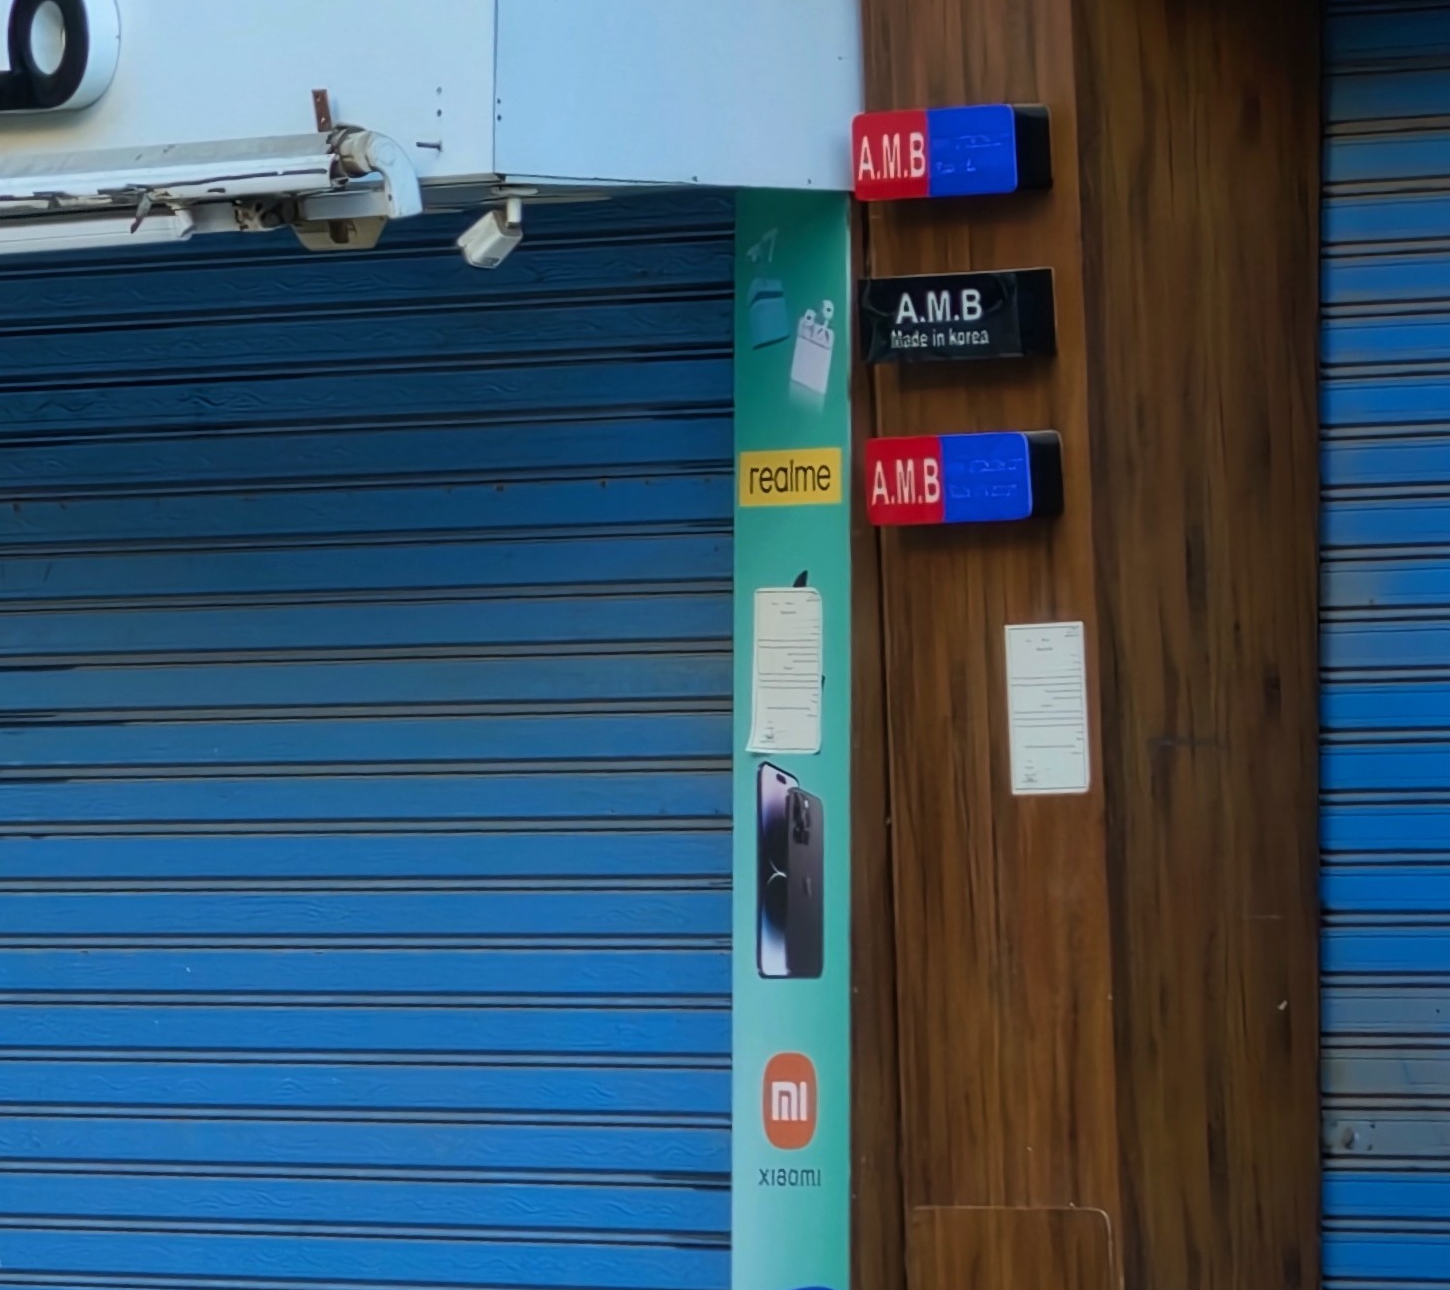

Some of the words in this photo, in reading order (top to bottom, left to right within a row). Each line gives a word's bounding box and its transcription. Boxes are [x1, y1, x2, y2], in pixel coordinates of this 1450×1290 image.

[895, 288, 983, 325] A.M.B
[891, 329, 928, 349] Made
[932, 328, 945, 347] in
[749, 459, 831, 495] realme
